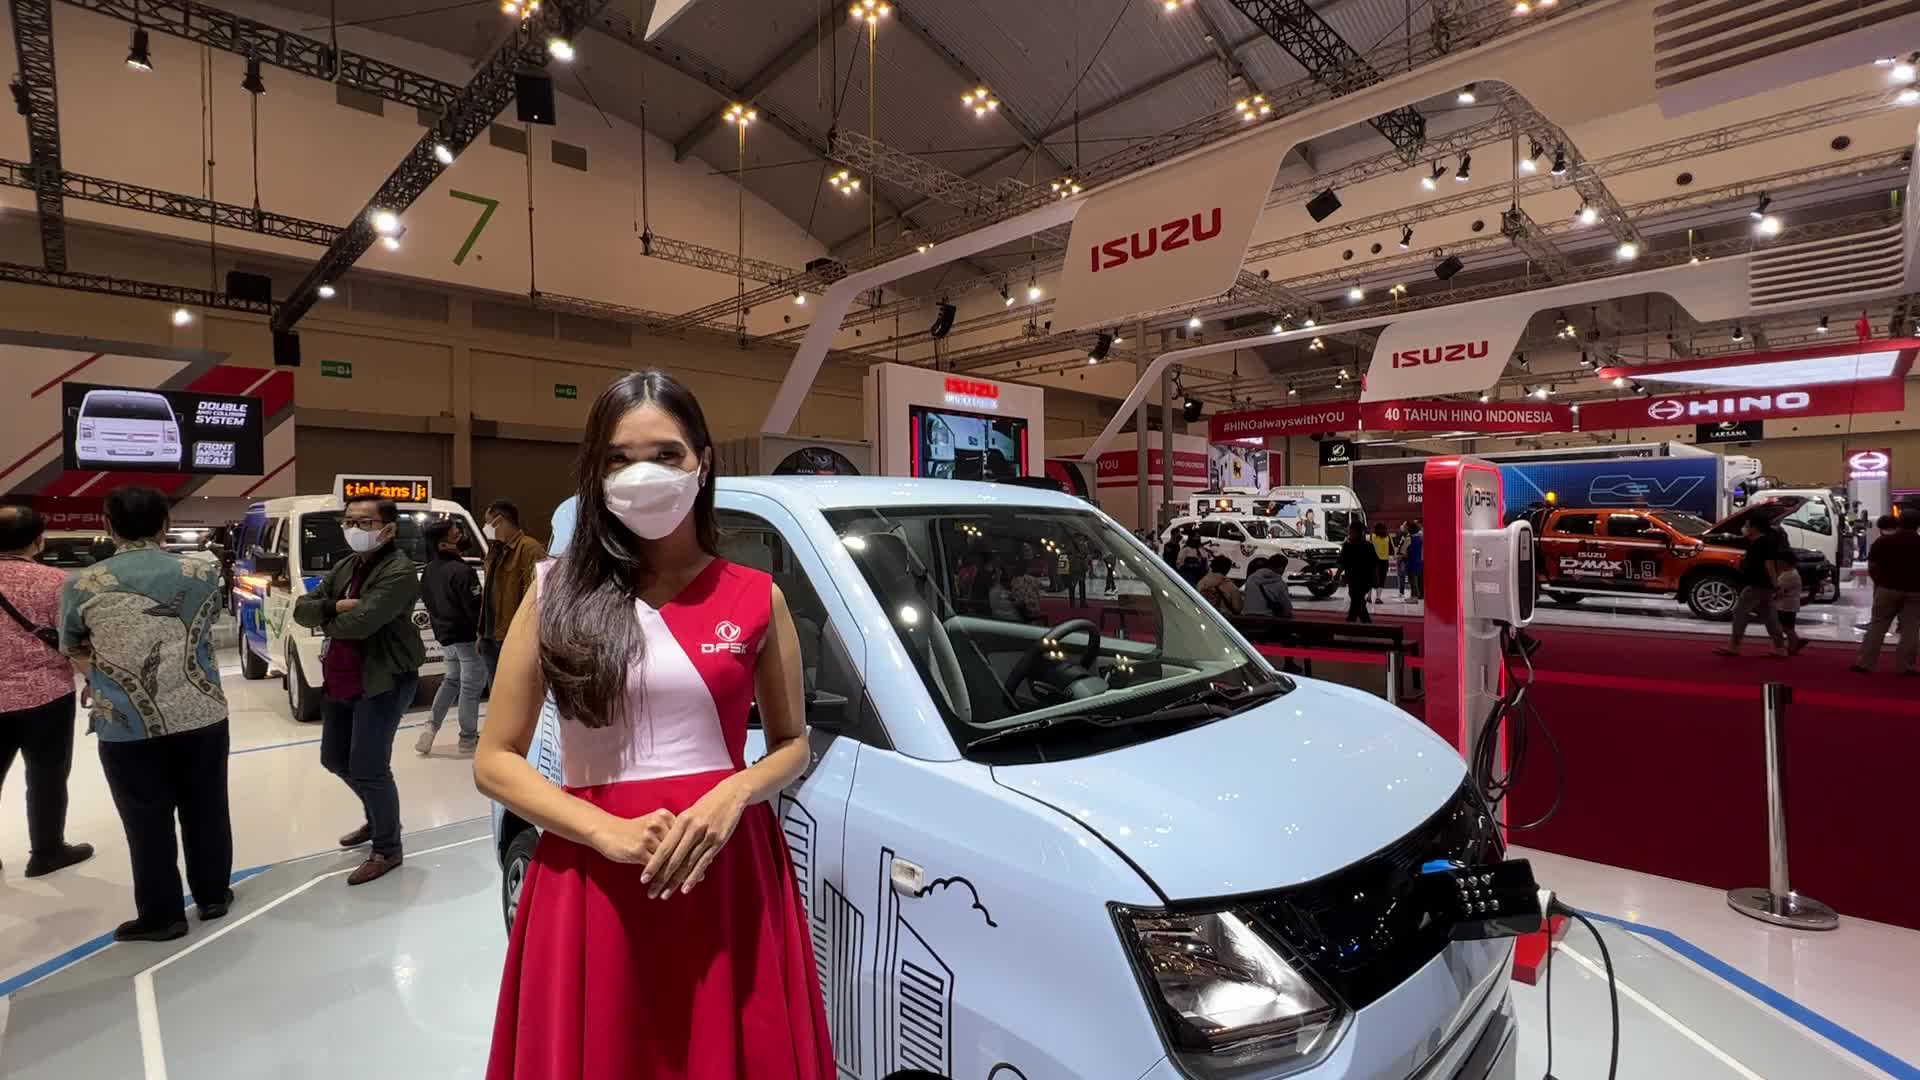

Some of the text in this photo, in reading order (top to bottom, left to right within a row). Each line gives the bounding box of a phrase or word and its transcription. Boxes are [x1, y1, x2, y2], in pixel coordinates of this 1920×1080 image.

[449, 190, 499, 265] 7
[1091, 207, 1221, 272] ISUZU
[1392, 341, 1489, 368] ISUZU
[944, 376, 1000, 398] ISUZU
[197, 401, 248, 412] DOUBLE
[1688, 391, 1810, 416] HINO
[195, 415, 245, 426] SYSTEM
[1223, 411, 1345, 433] #HINOalwayswithYOU
[1384, 407, 1553, 424] 40 TAHUN HINO INDONESIA
[197, 442, 233, 450] FRONT
